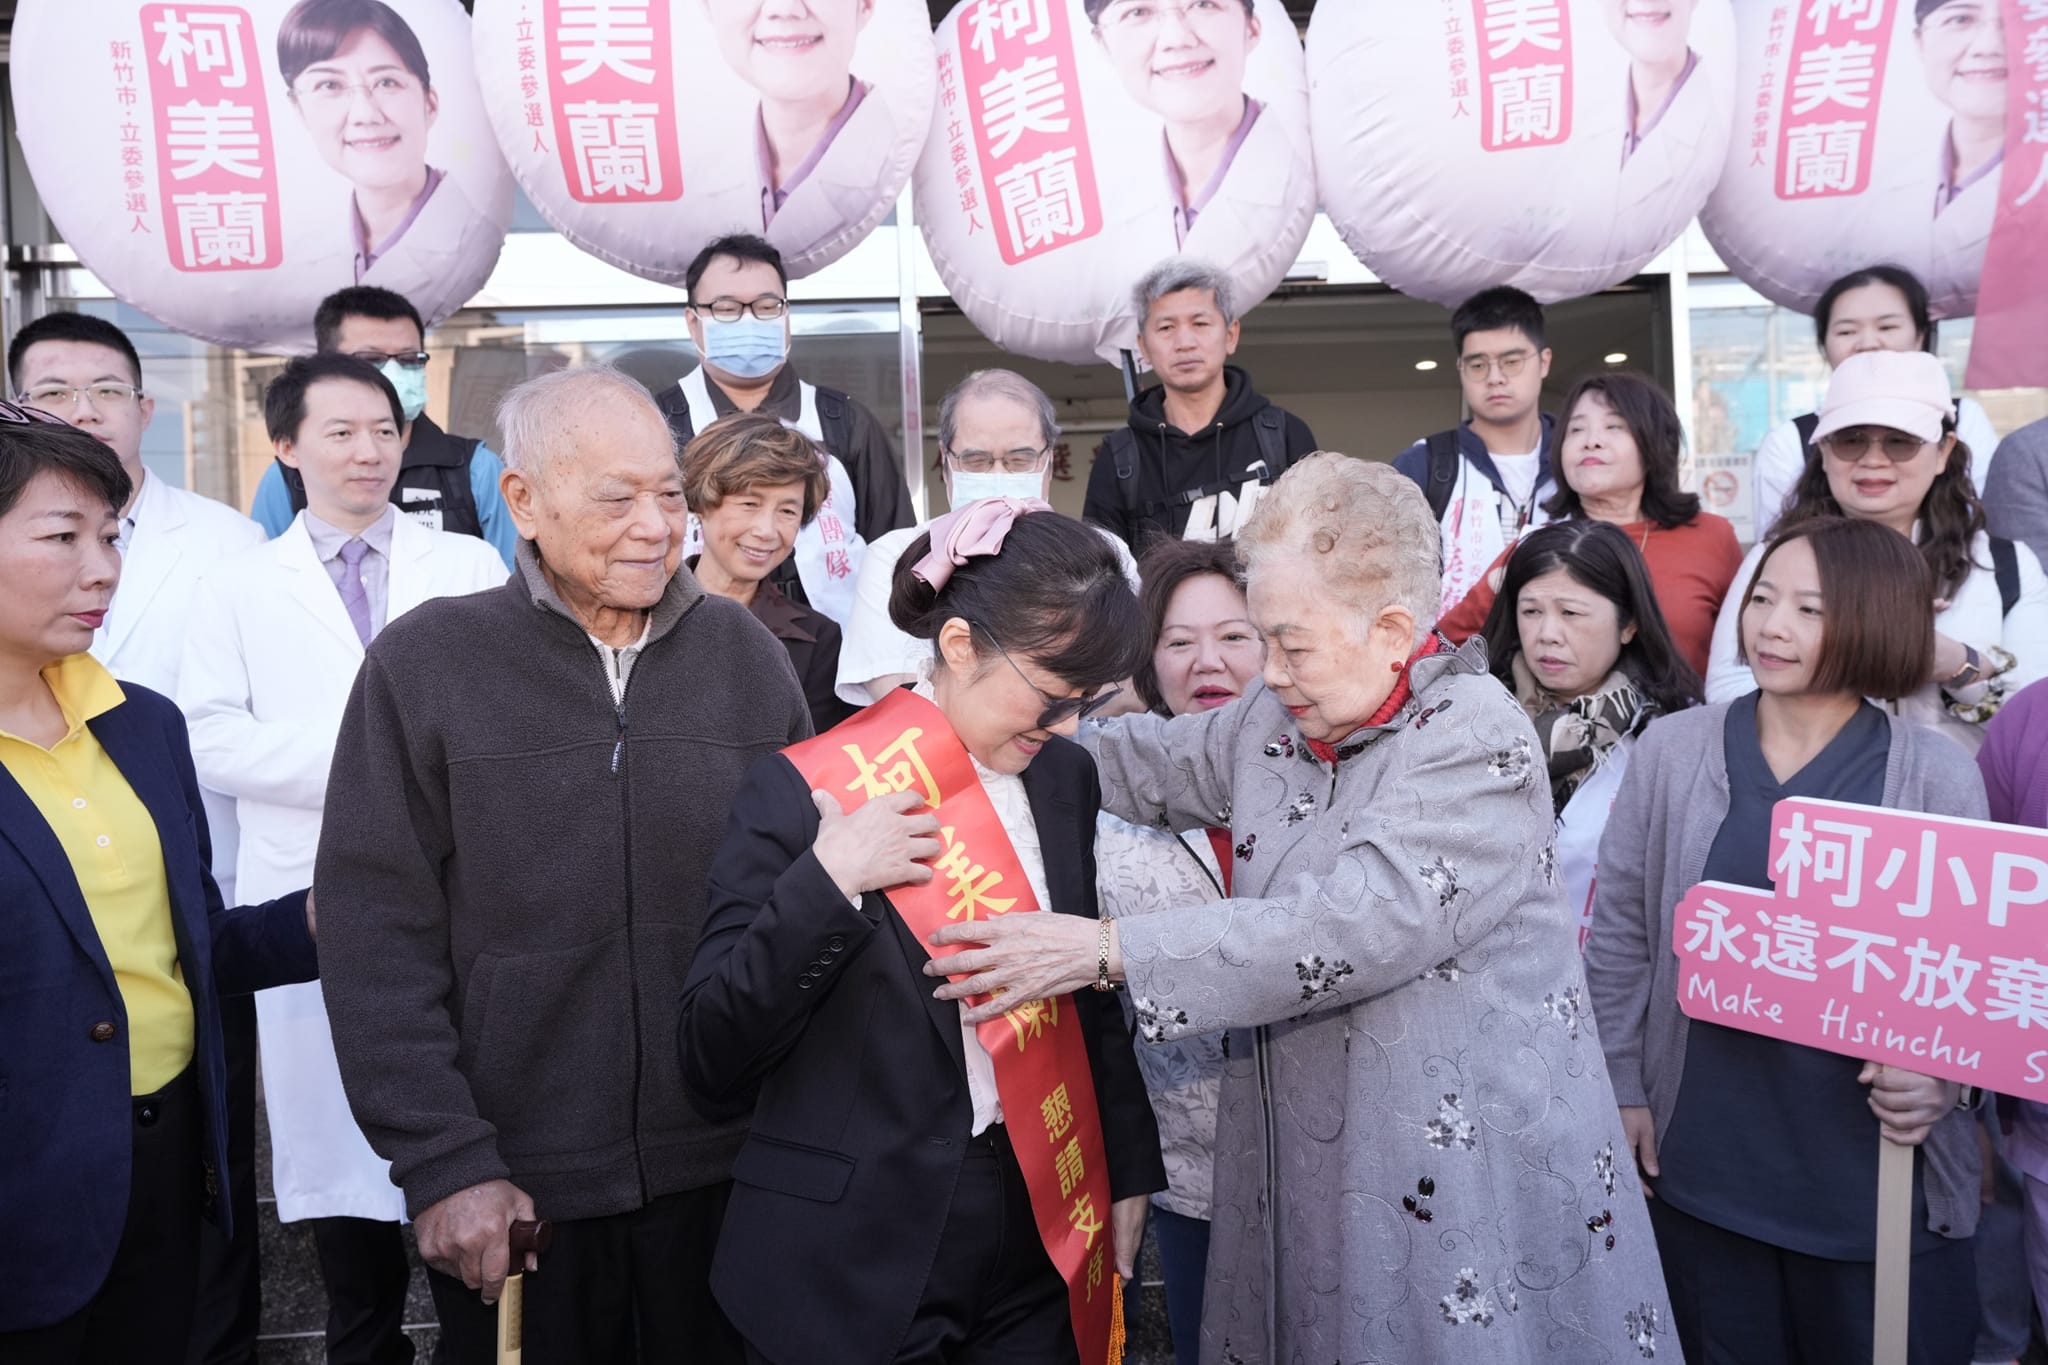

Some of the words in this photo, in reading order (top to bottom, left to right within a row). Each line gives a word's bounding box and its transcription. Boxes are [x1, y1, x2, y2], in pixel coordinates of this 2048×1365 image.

[556, 0, 664, 196] 美蘭
[967, 0, 1086, 257] 柯美蘭
[1442, 0, 1470, 119] ·立委參選人
[1483, 0, 1566, 147] 美蘭
[153, 8, 268, 268] 柯美蘭
[1775, 811, 2048, 928] 柯小P
[1683, 898, 2048, 1030] 永遠不放棄
[1687, 972, 1784, 1024] Make
[1819, 999, 1982, 1070] Hsinchu
[1040, 1081, 1104, 1304] 懇請支持
